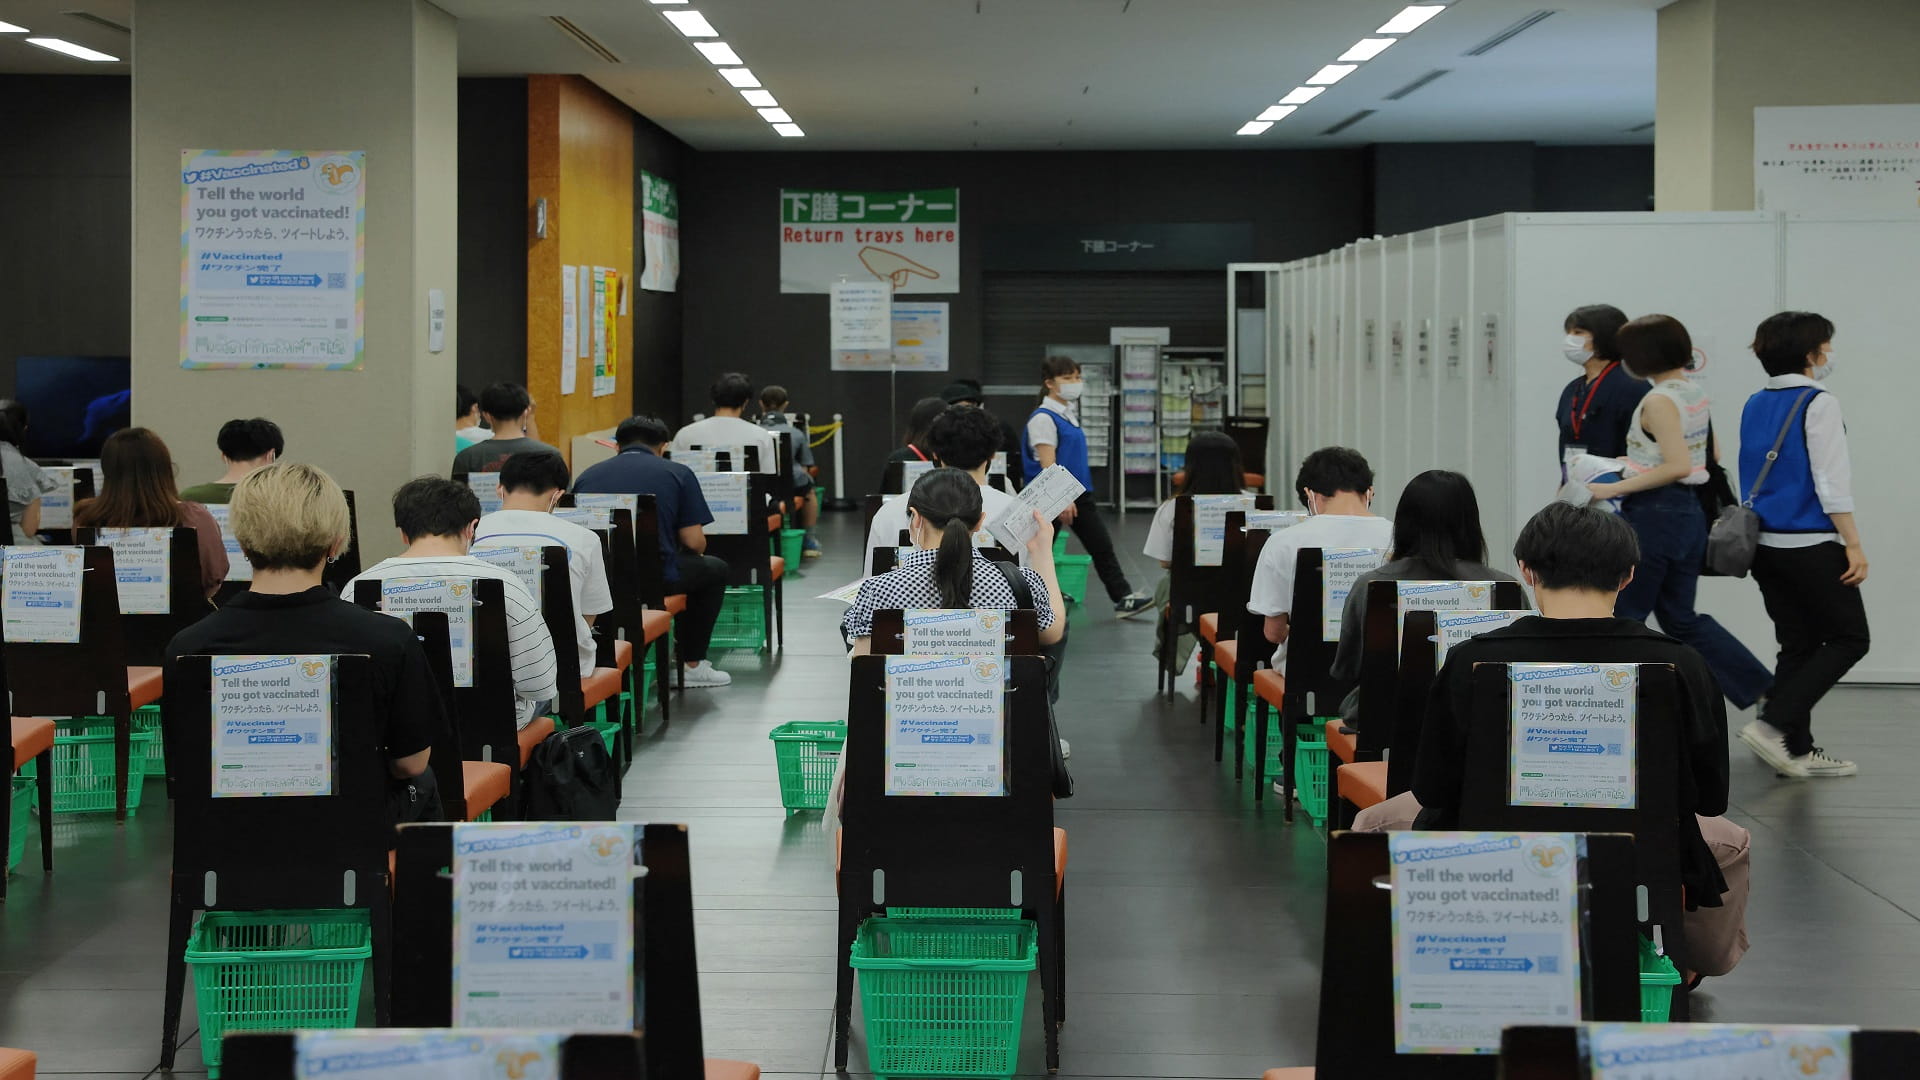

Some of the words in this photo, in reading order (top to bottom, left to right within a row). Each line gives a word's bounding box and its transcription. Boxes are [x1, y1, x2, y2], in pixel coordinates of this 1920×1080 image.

[199, 158, 299, 182] #Vaccinated
[196, 187, 225, 200] Tell
[229, 187, 255, 200] the
[258, 187, 305, 200] world
[783, 192, 953, 222] 下膳コーナー
[196, 207, 226, 221] you
[230, 207, 258, 222] got
[262, 206, 349, 219] vaccinated!
[784, 227, 844, 242] Return
[855, 228, 904, 244] trays
[914, 227, 955, 243] here
[200, 252, 283, 261] #Vaccinated
[38, 570, 76, 578] vaccinated!
[1344, 570, 1356, 578] got
[389, 596, 404, 604] Tell
[405, 596, 417, 604] the
[418, 596, 442, 604] world
[1436, 598, 1460, 606] world
[912, 628, 928, 636] Tell
[930, 628, 944, 636] the
[945, 628, 971, 636] world
[912, 640, 928, 648] you
[930, 640, 946, 648] got
[221, 679, 240, 687] Tell
[242, 678, 258, 687] the
[261, 677, 290, 687] world
[896, 677, 914, 686] Tell
[917, 677, 932, 686] the
[935, 677, 964, 686] world
[221, 692, 240, 702] you
[243, 691, 260, 702] got
[263, 689, 320, 698] vaccinated!
[896, 691, 914, 700] you
[917, 691, 934, 701] got
[937, 690, 993, 699] vaccinated!
[1522, 685, 1541, 694] Tell
[1544, 685, 1561, 694] the
[1564, 686, 1594, 695] world
[1522, 699, 1542, 708] you
[1545, 699, 1562, 709] got
[1565, 698, 1624, 708] vaccinated!
[468, 859, 497, 872] Tell
[500, 859, 522, 872] the
[529, 858, 572, 872] world
[1407, 869, 1434, 883] Tell
[1439, 869, 1464, 882] the
[1468, 868, 1513, 883] world
[469, 880, 497, 894] you
[501, 880, 527, 894] got
[531, 878, 616, 891] vaccinated!
[1407, 890, 1436, 904] you
[1440, 889, 1467, 904] got
[1471, 888, 1560, 901] vaccinated!
[1416, 935, 1506, 943] #Vaccinated
